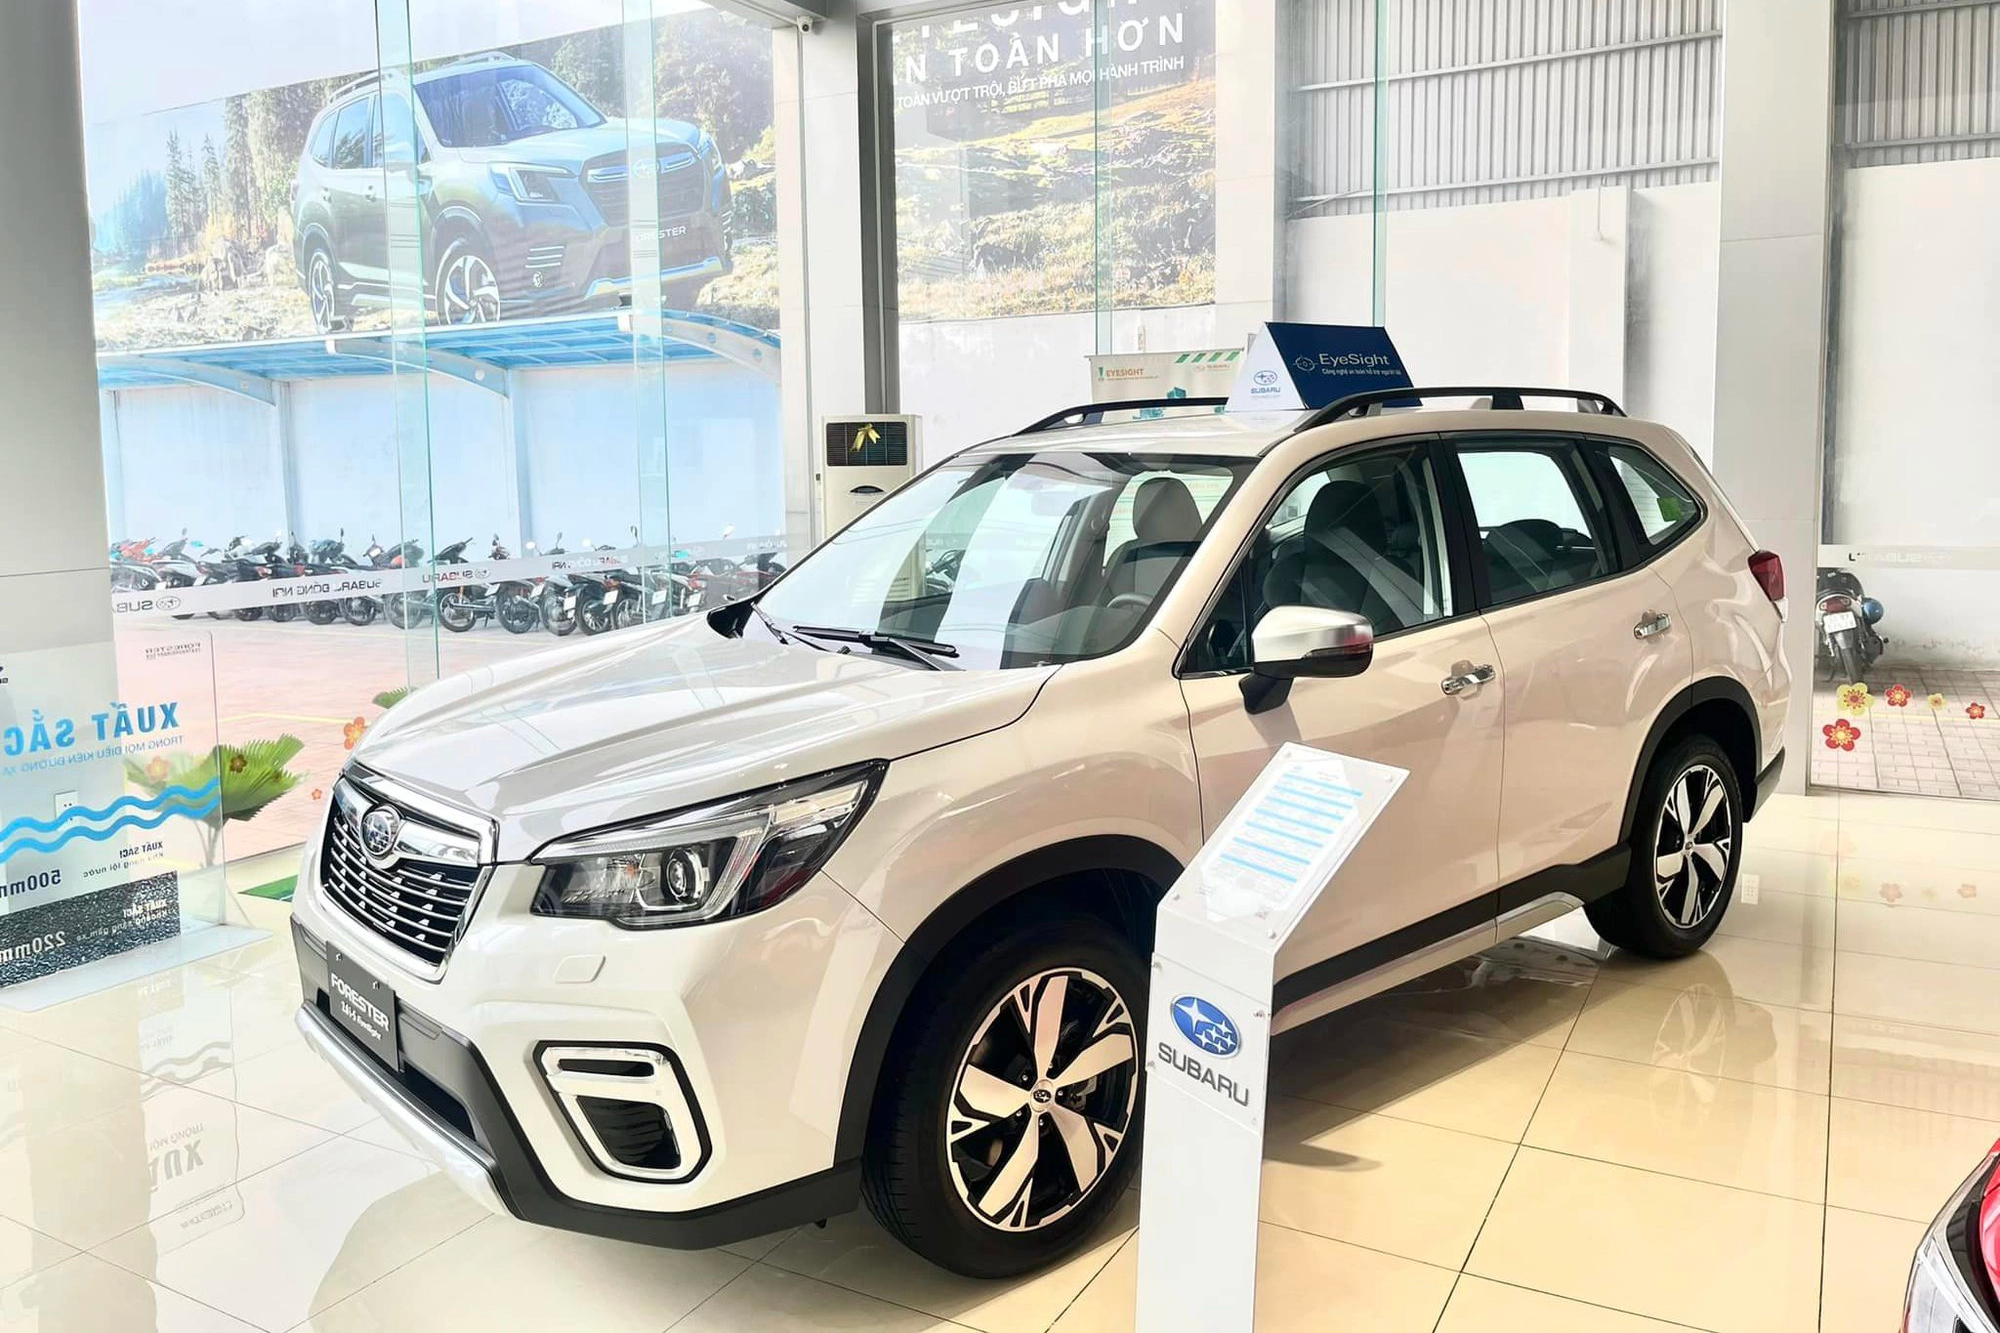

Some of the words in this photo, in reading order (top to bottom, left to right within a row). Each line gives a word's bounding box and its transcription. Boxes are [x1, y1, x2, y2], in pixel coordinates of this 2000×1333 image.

[948, 31, 1059, 77] TOÀN
[1085, 12, 1184, 58] HƠN
[1140, 55, 1184, 75] TRÌNH
[1319, 353, 1390, 368] EyeSight
[1106, 368, 1145, 378] EYESIGHT
[1250, 387, 1281, 395] SUBARU
[330, 972, 390, 1032] FORESTER
[1158, 1041, 1249, 1107] SUBARU
